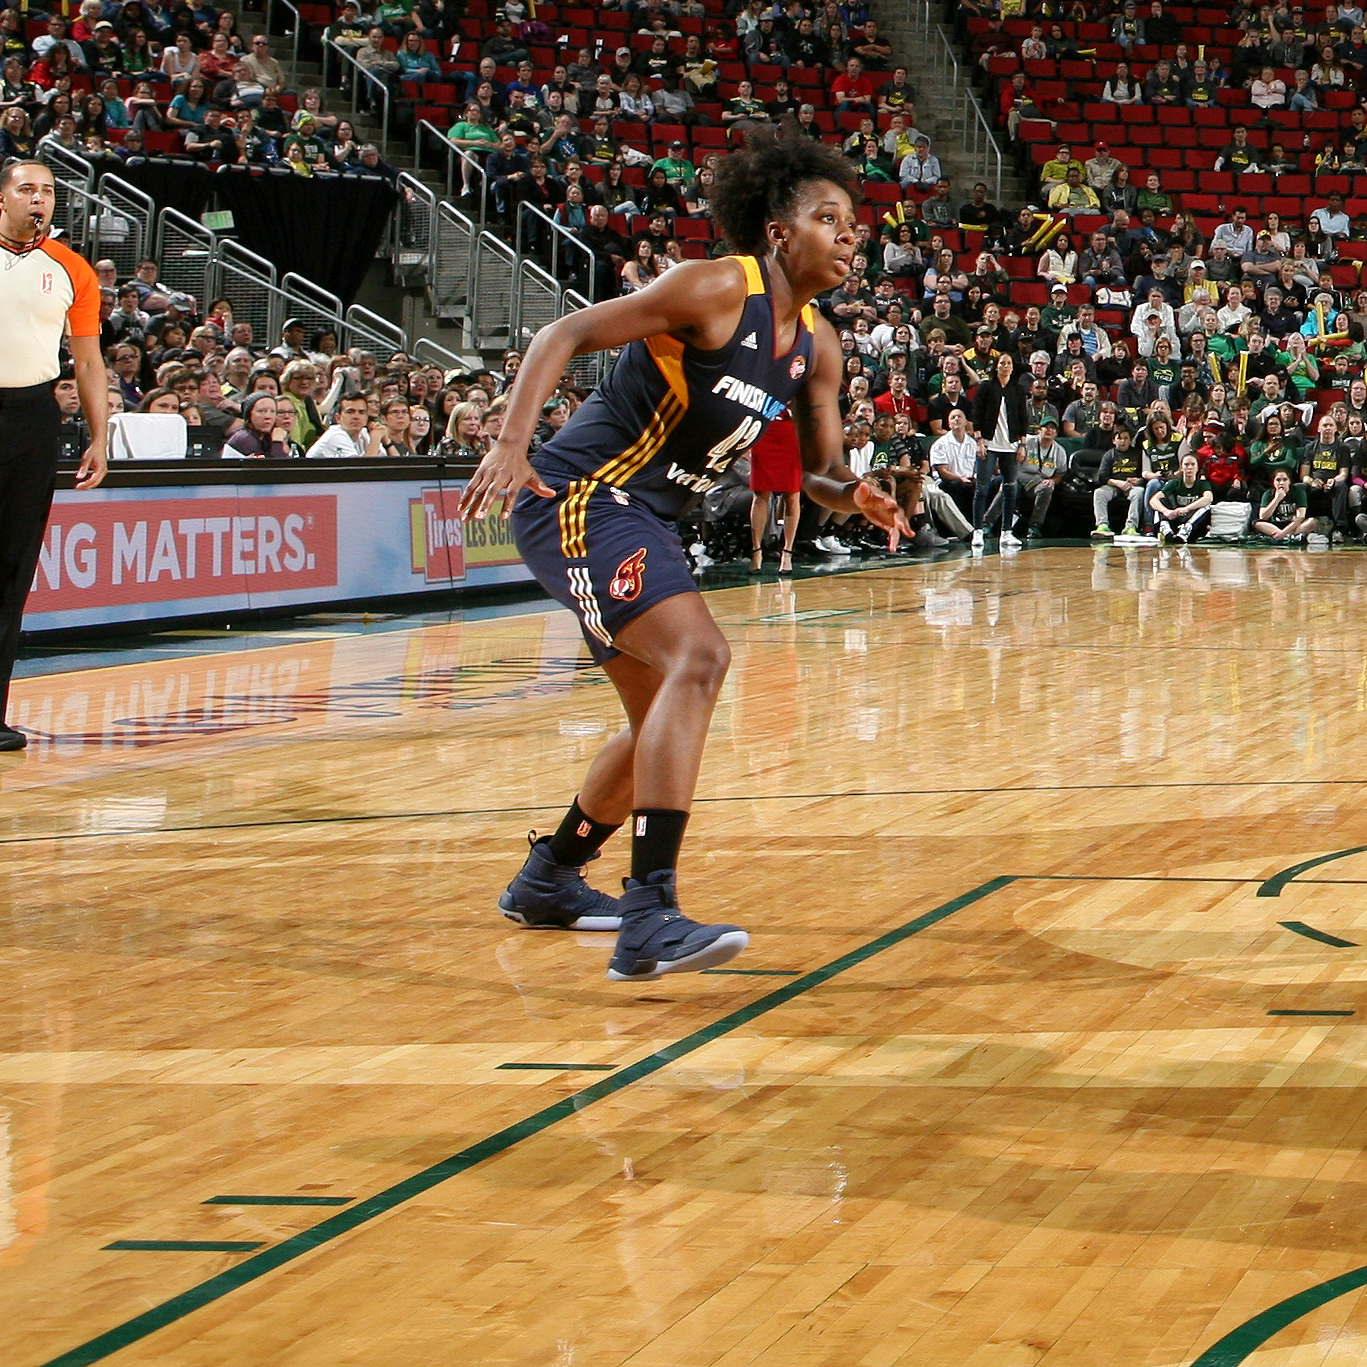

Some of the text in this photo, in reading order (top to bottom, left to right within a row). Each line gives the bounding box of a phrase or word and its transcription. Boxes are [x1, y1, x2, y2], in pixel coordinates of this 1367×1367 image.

[711, 375, 767, 413] FINISH
[111, 513, 316, 585] MATTERS.
[424, 503, 461, 557] Tires
[465, 519, 487, 548] LES
